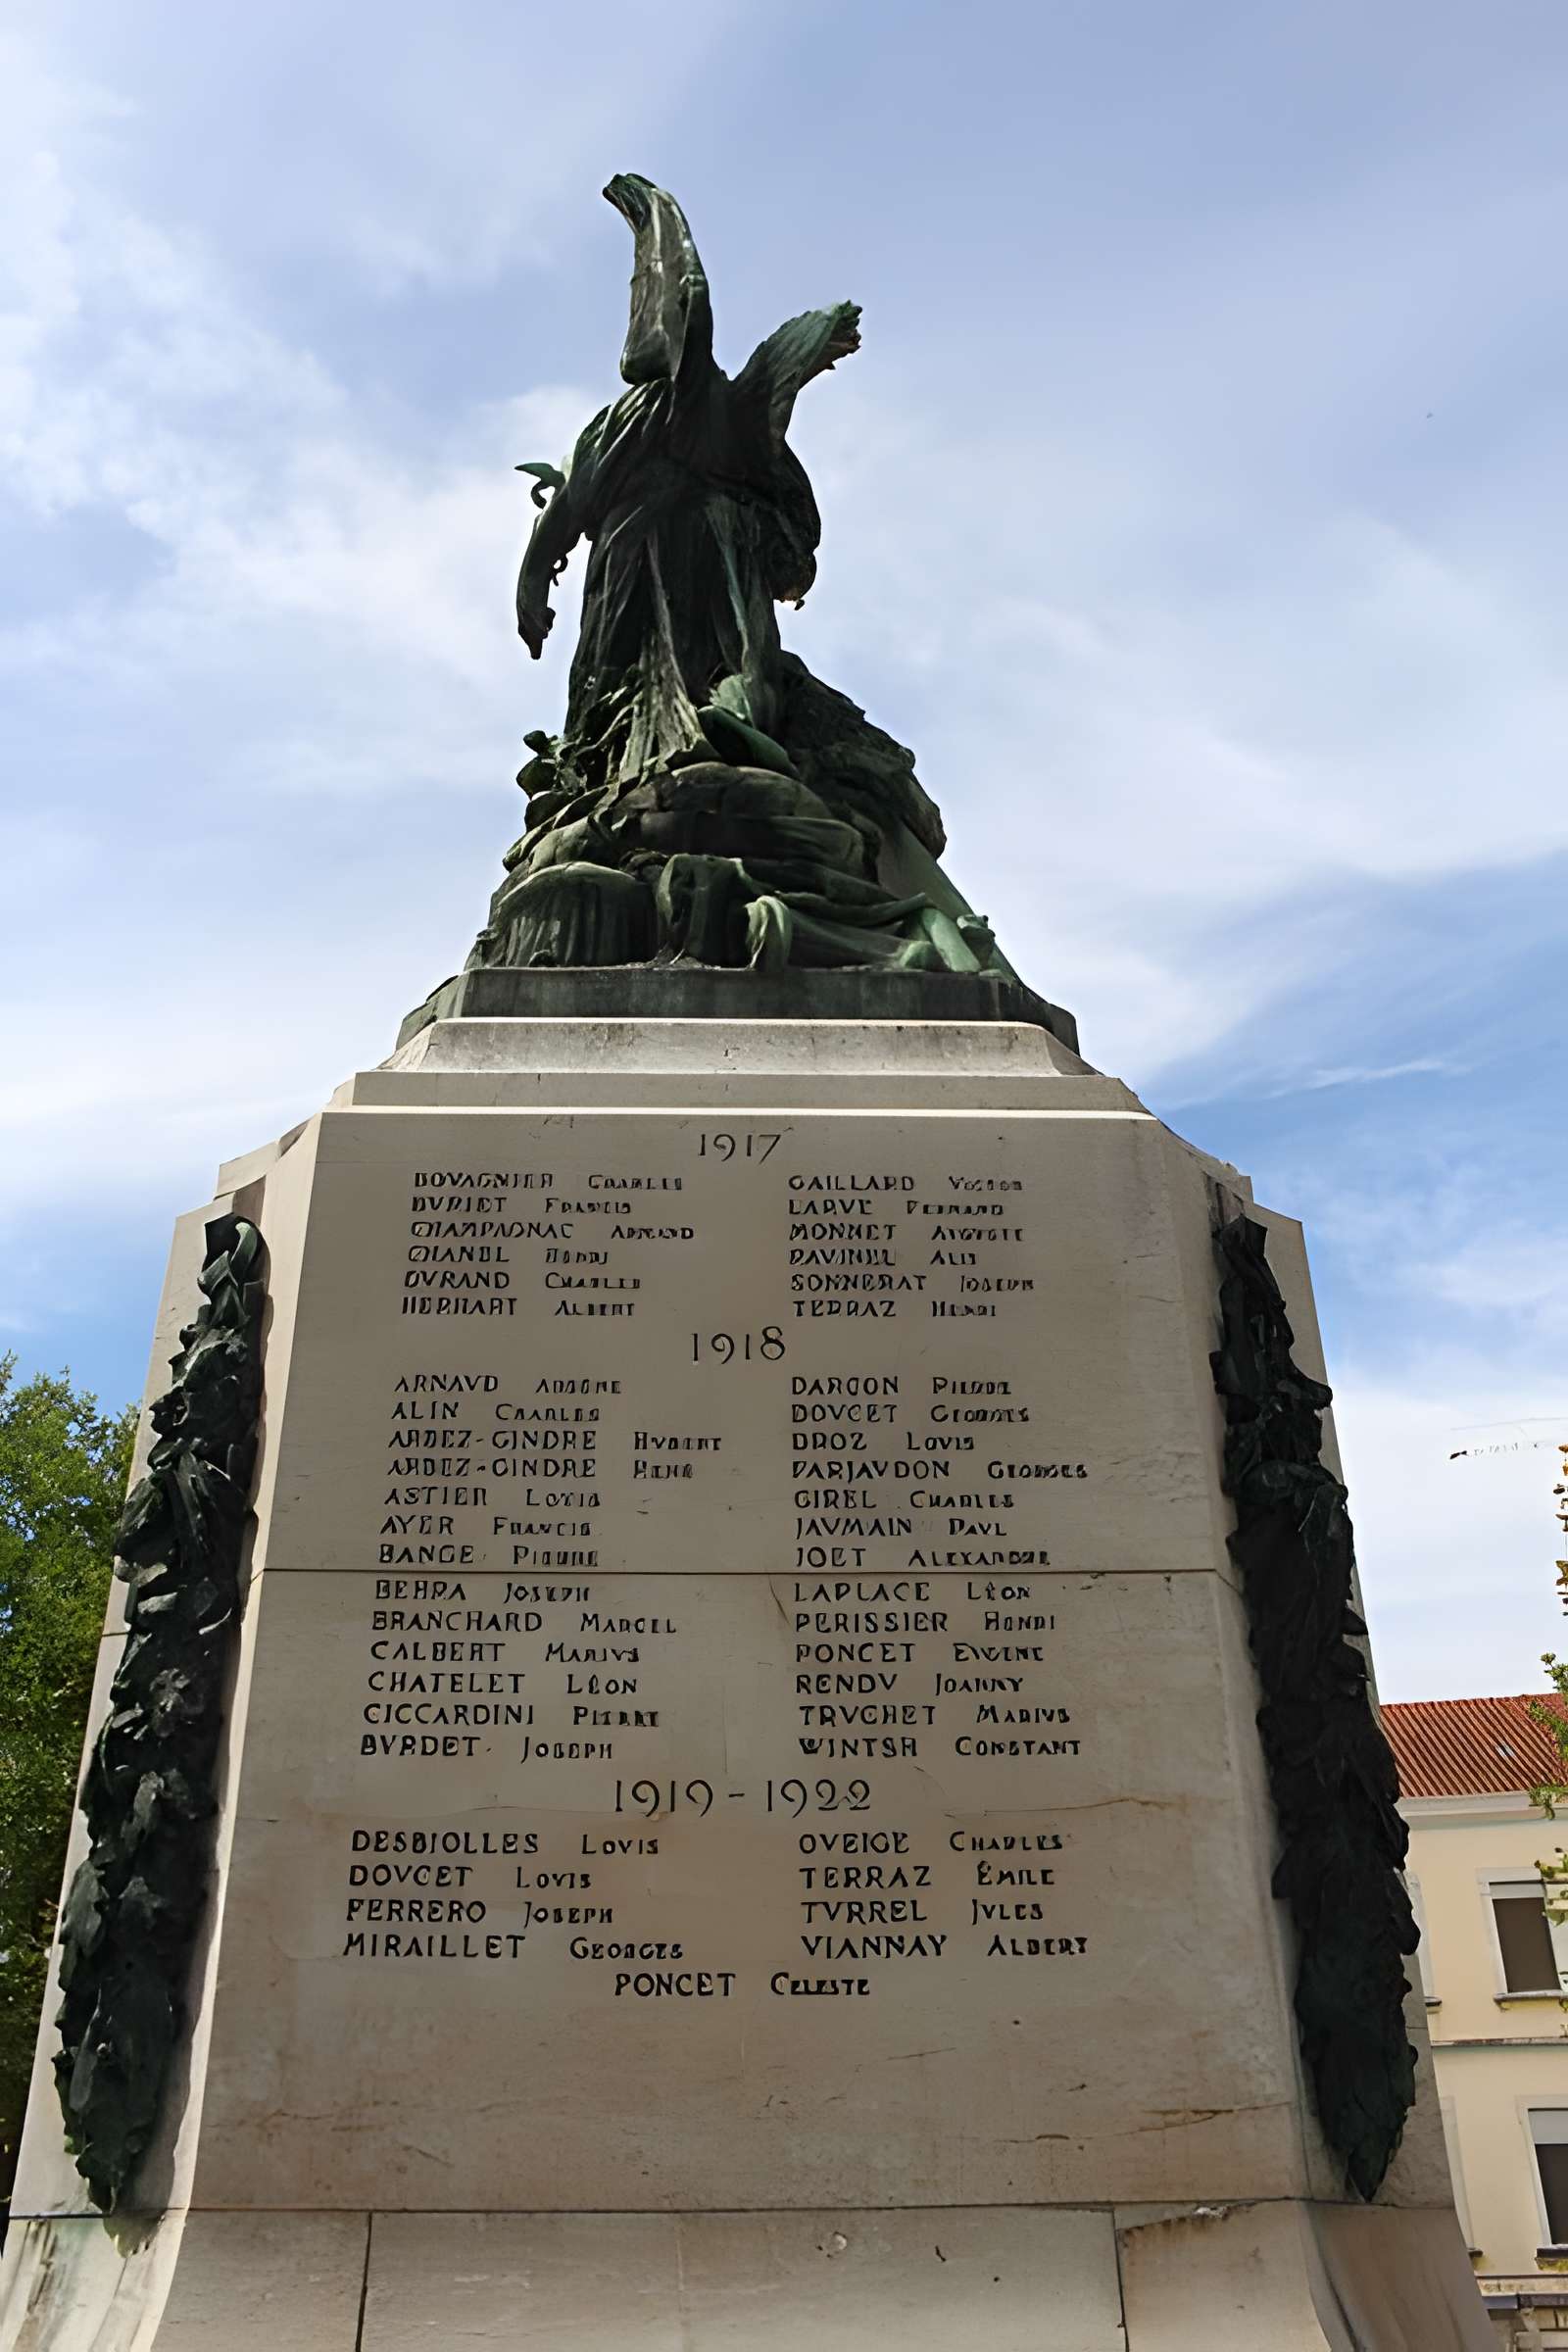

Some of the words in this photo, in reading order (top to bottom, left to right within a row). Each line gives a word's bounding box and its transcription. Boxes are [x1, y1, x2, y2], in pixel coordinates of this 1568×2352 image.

[697, 1133, 782, 1165] 1917
[788, 1174, 915, 1192] GAILLARD
[788, 1222, 898, 1242] MONNET
[404, 1269, 511, 1290] DVRAND
[791, 1273, 927, 1294] SONNERAT
[792, 1298, 897, 1318] TERRAZ
[691, 1325, 786, 1365] 1918
[393, 1373, 499, 1394] ARNAVD
[390, 1400, 460, 1420] ALIN
[791, 1403, 898, 1424] DOVCET
[791, 1432, 867, 1451] DROZ
[906, 1431, 975, 1451] LOVIS
[383, 1486, 487, 1506] ASTIER
[794, 1489, 877, 1510] GIREL
[909, 1490, 1015, 1509] CHARLES
[796, 1516, 912, 1541] JAVMAIN
[948, 1517, 1007, 1537] PAVL
[503, 1582, 591, 1604] JOSEPH
[794, 1581, 930, 1603] LAPLACE
[371, 1609, 543, 1633] BRANCHARD
[579, 1612, 677, 1635] MARCEL
[795, 1611, 949, 1634] PERISSIER
[369, 1640, 507, 1662] CALBERT
[544, 1642, 640, 1663] MARIVS
[796, 1642, 916, 1664] PONCET
[368, 1670, 526, 1694] CHATELET
[796, 1672, 899, 1695] RENDV
[935, 1672, 1024, 1697] JOANNY
[363, 1702, 534, 1727] CICCARDINI
[799, 1704, 936, 1728] TRVCHET
[975, 1703, 1071, 1724] MARIVS
[955, 1736, 1081, 1757] CONSTANT
[351, 1829, 539, 1855] DESBIOLLES
[581, 1834, 659, 1855] LOVIS
[949, 1830, 1063, 1852] CHARLES
[349, 1863, 474, 1888] DOVCET
[515, 1865, 592, 1889] LOVIS
[798, 1865, 932, 1889] TERRAZ
[346, 1897, 487, 1924] FERRERO
[800, 1899, 928, 1926] TVRREL
[971, 1898, 1044, 1927] JVLES
[342, 1932, 526, 1959] MIRAILLET
[569, 1936, 684, 1960] GEORGES
[800, 1934, 948, 1960] VIANNAY
[987, 1934, 1089, 1957] ALBERT
[614, 1972, 737, 1997] PONCET
